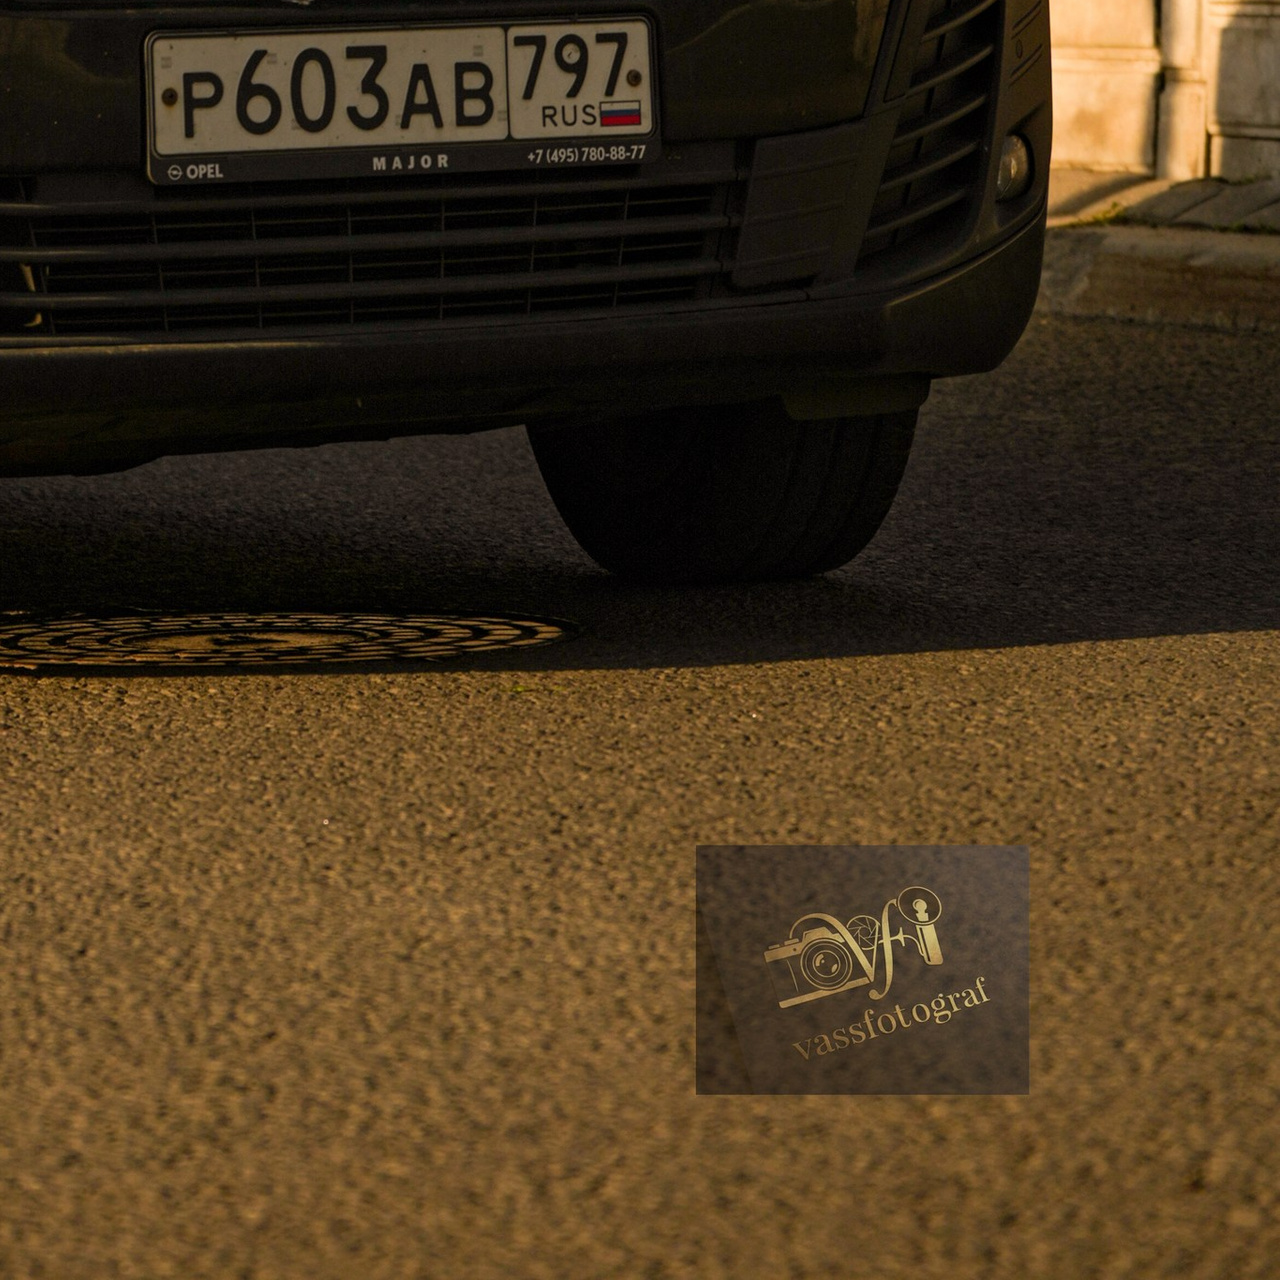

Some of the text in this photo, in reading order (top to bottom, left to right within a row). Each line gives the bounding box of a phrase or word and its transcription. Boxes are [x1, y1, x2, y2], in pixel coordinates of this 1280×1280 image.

[513, 31, 629, 101] 797
[541, 104, 597, 127] RUS
[372, 153, 449, 172] MAJOR
[527, 144, 646, 165] +7 (495) 780-88-77
[186, 163, 224, 180] OPEL
